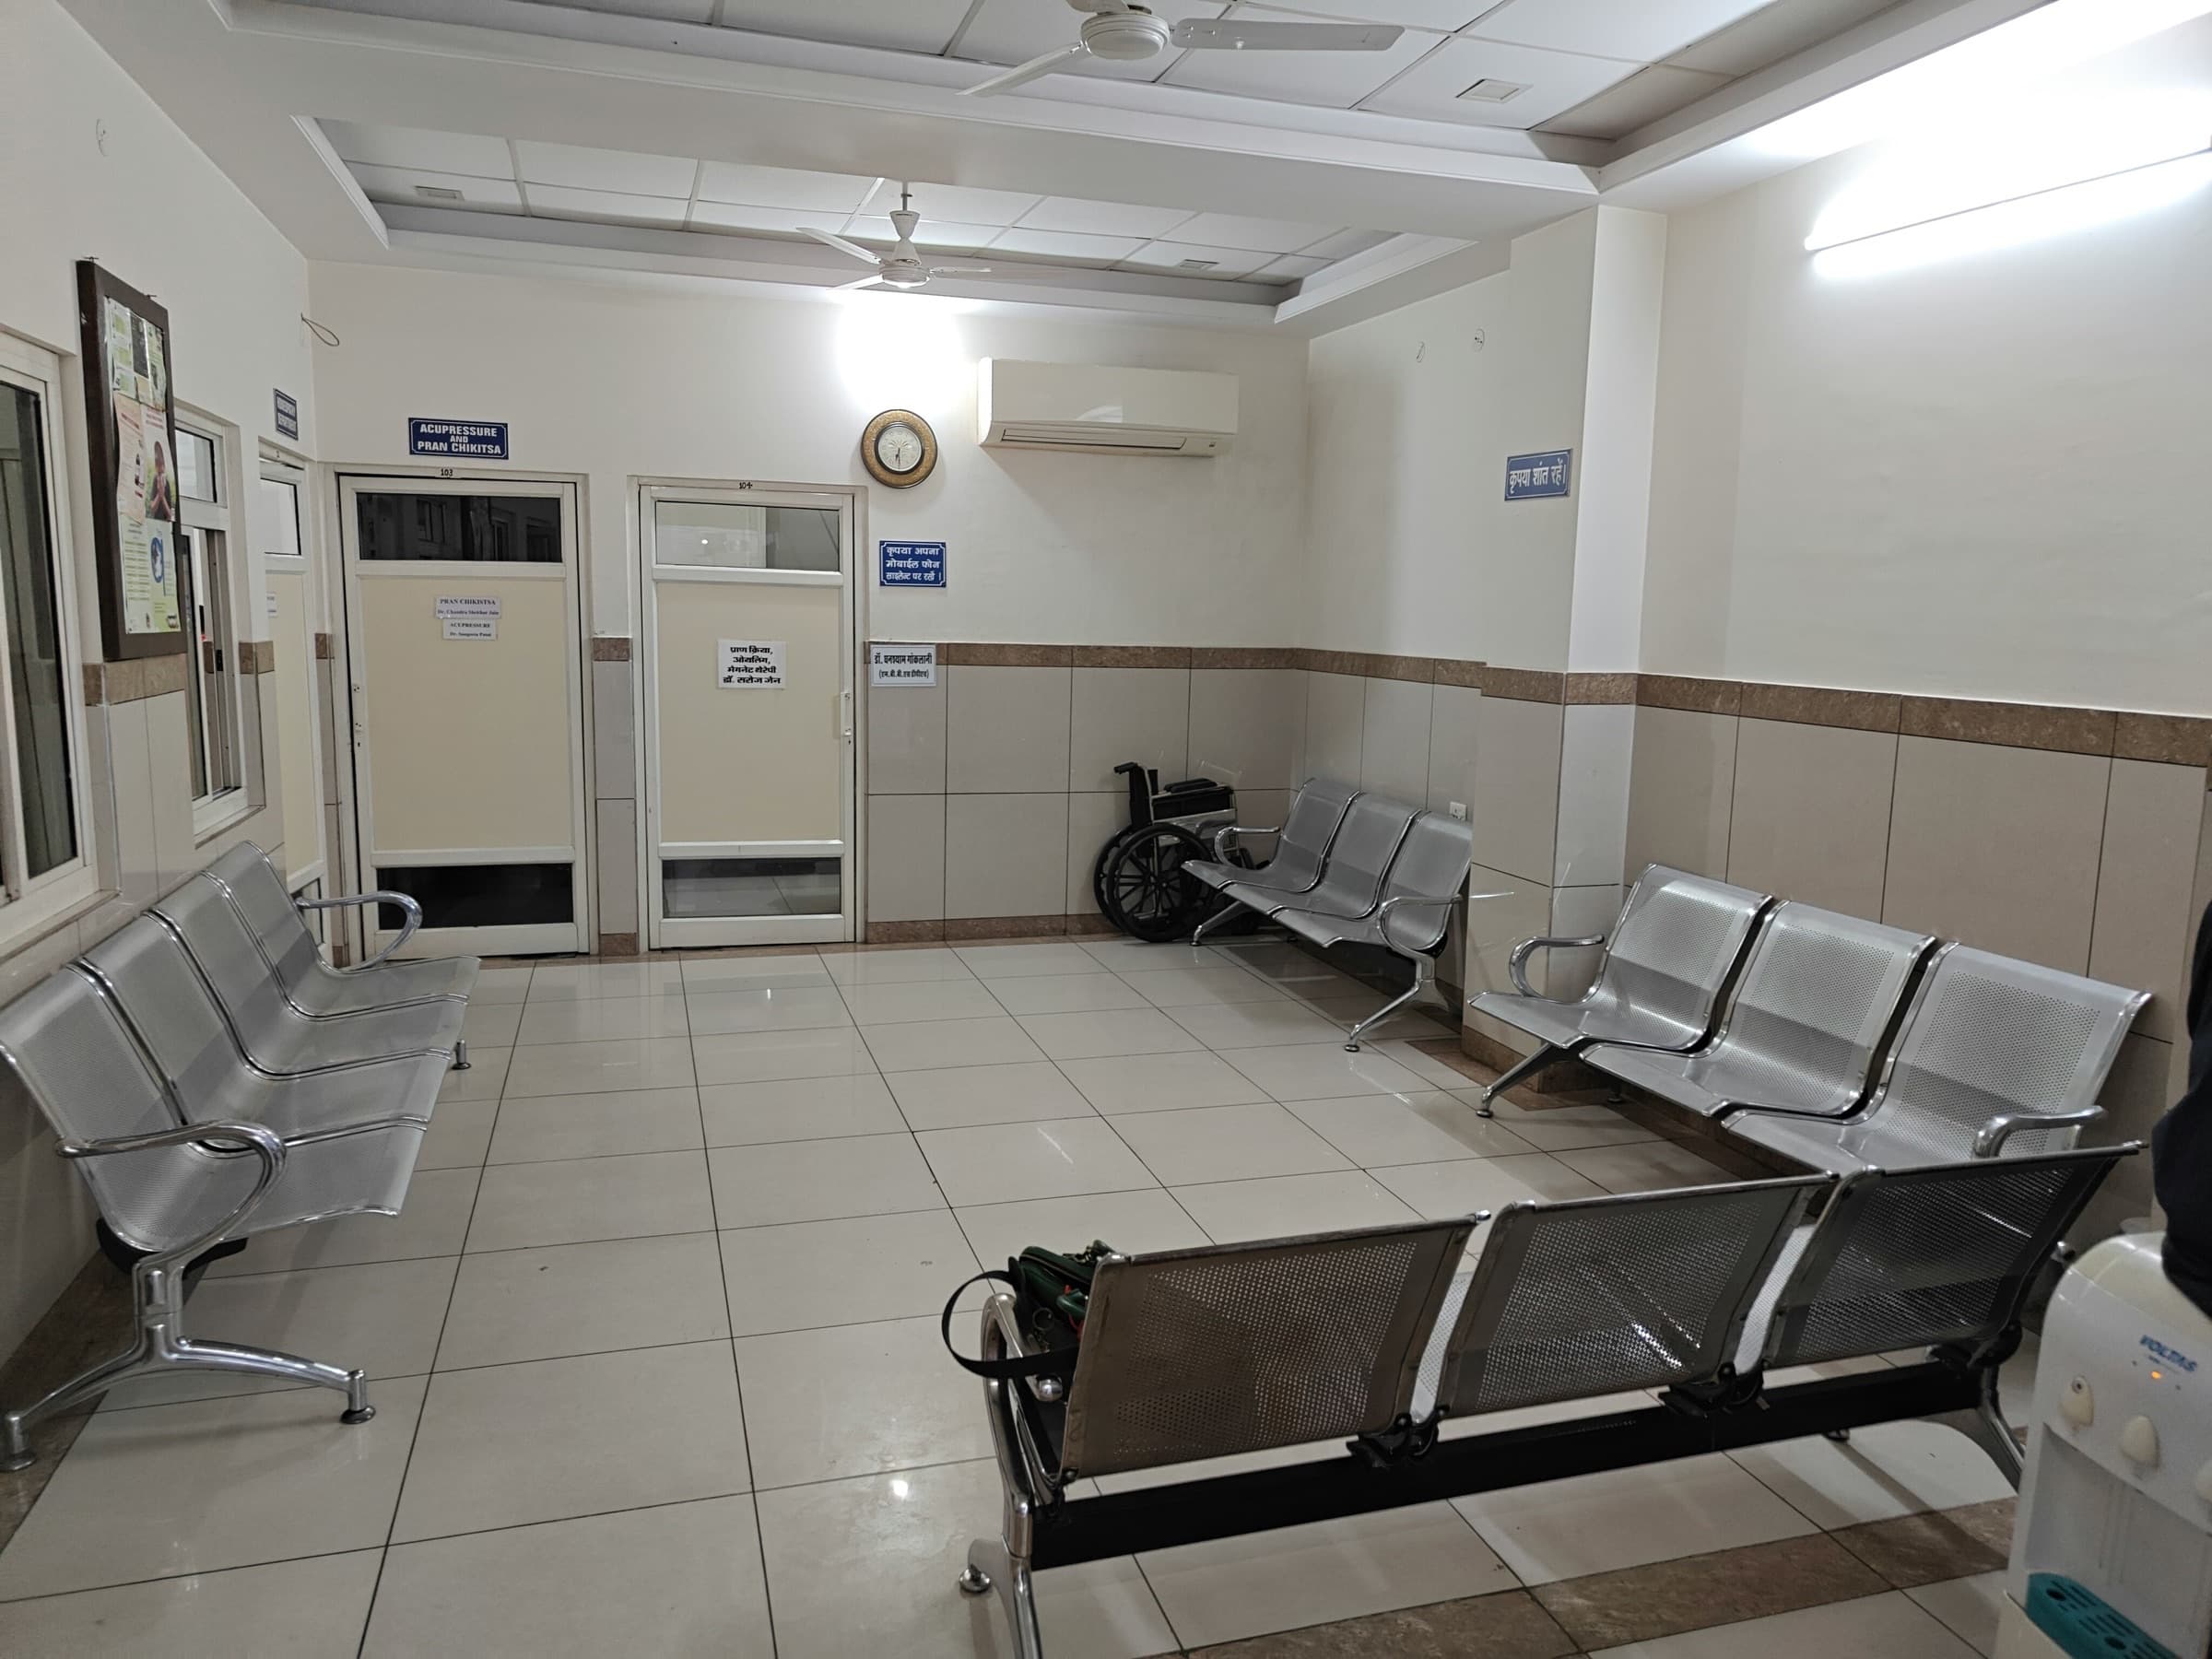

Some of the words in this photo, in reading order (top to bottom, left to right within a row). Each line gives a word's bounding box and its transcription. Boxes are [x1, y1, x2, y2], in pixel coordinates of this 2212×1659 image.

[419, 423, 498, 437] ACUPRESSURE
[450, 435, 468, 443] AND
[418, 441, 448, 452] PRAN
[451, 442, 501, 454] CHIKITSA
[441, 468, 453, 477] 103
[1509, 468, 1531, 494] कृपया
[1533, 461, 1549, 487] शांत
[738, 481, 753, 489] 104
[886, 547, 912, 557] कृपया
[922, 559, 940, 569] फोन
[912, 572, 923, 581] पर
